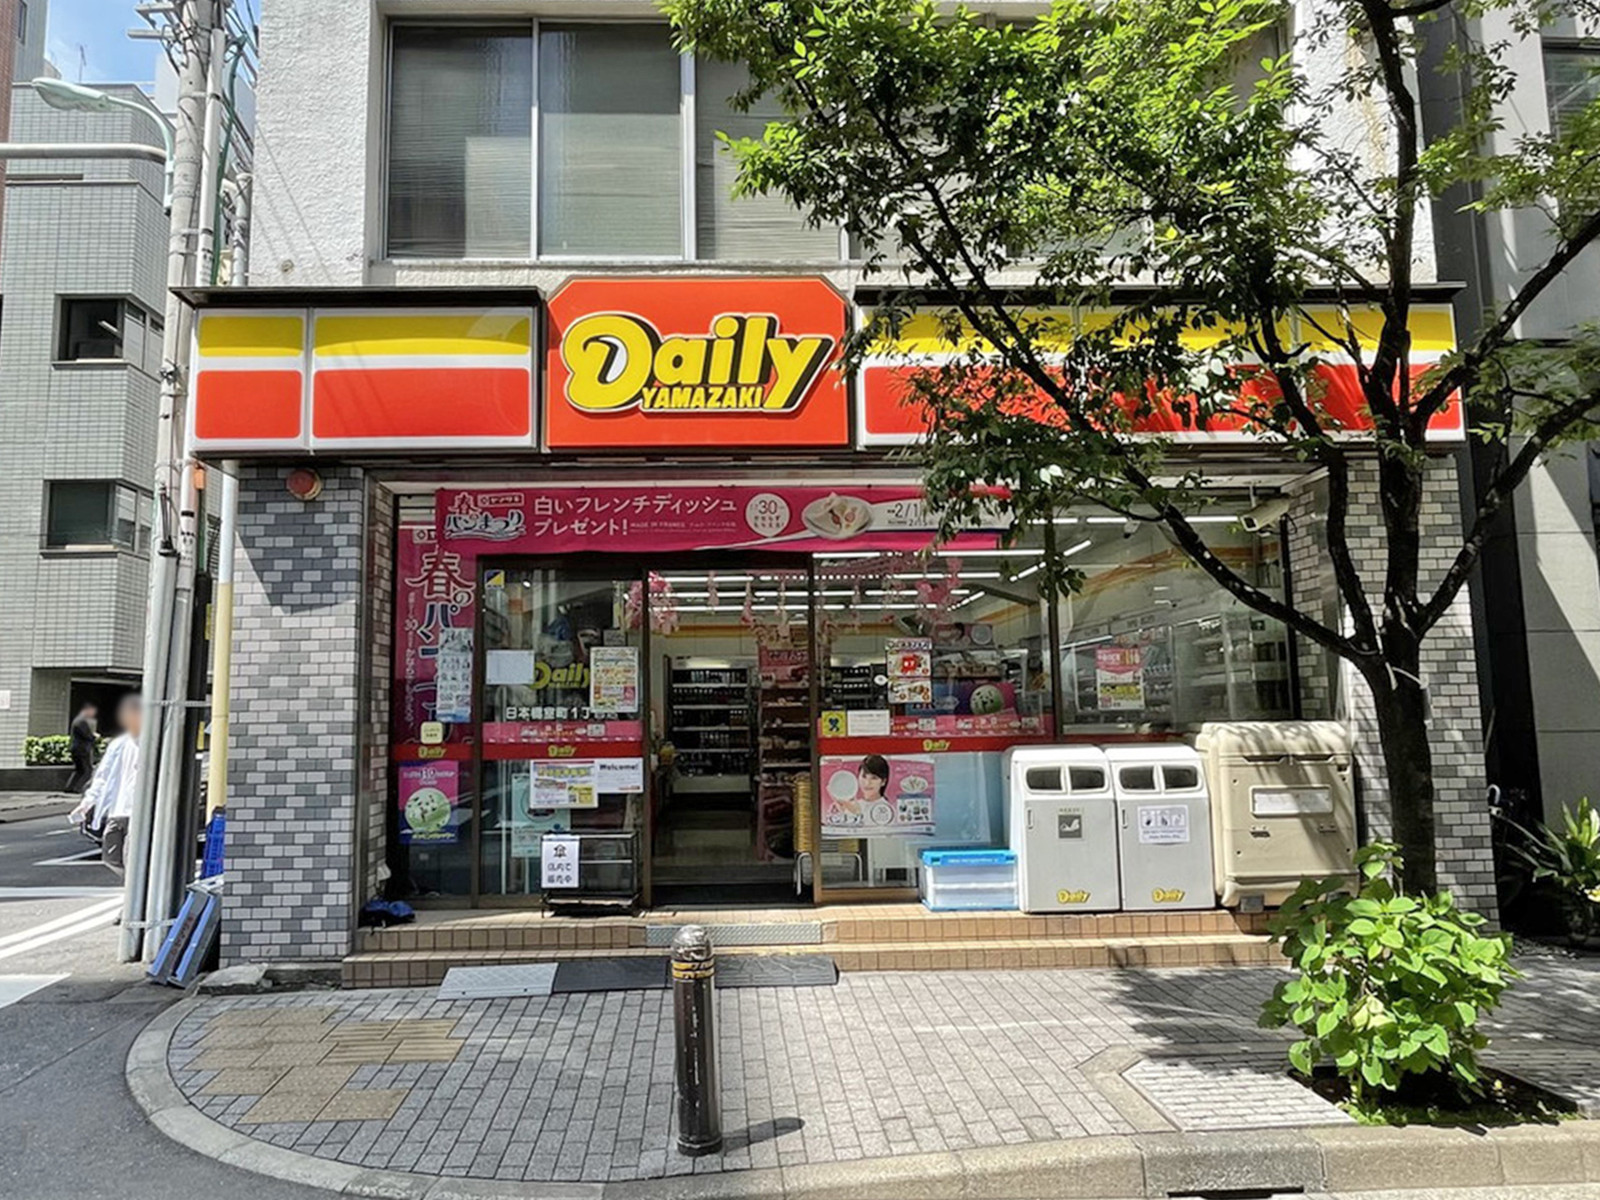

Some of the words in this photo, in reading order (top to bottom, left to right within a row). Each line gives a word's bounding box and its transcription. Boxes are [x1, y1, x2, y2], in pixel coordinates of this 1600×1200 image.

[562, 313, 832, 410] Daily
[642, 386, 763, 409] YAMAZAKI
[534, 494, 737, 516] 白いフレンチディッシュ
[758, 499, 778, 515] 30
